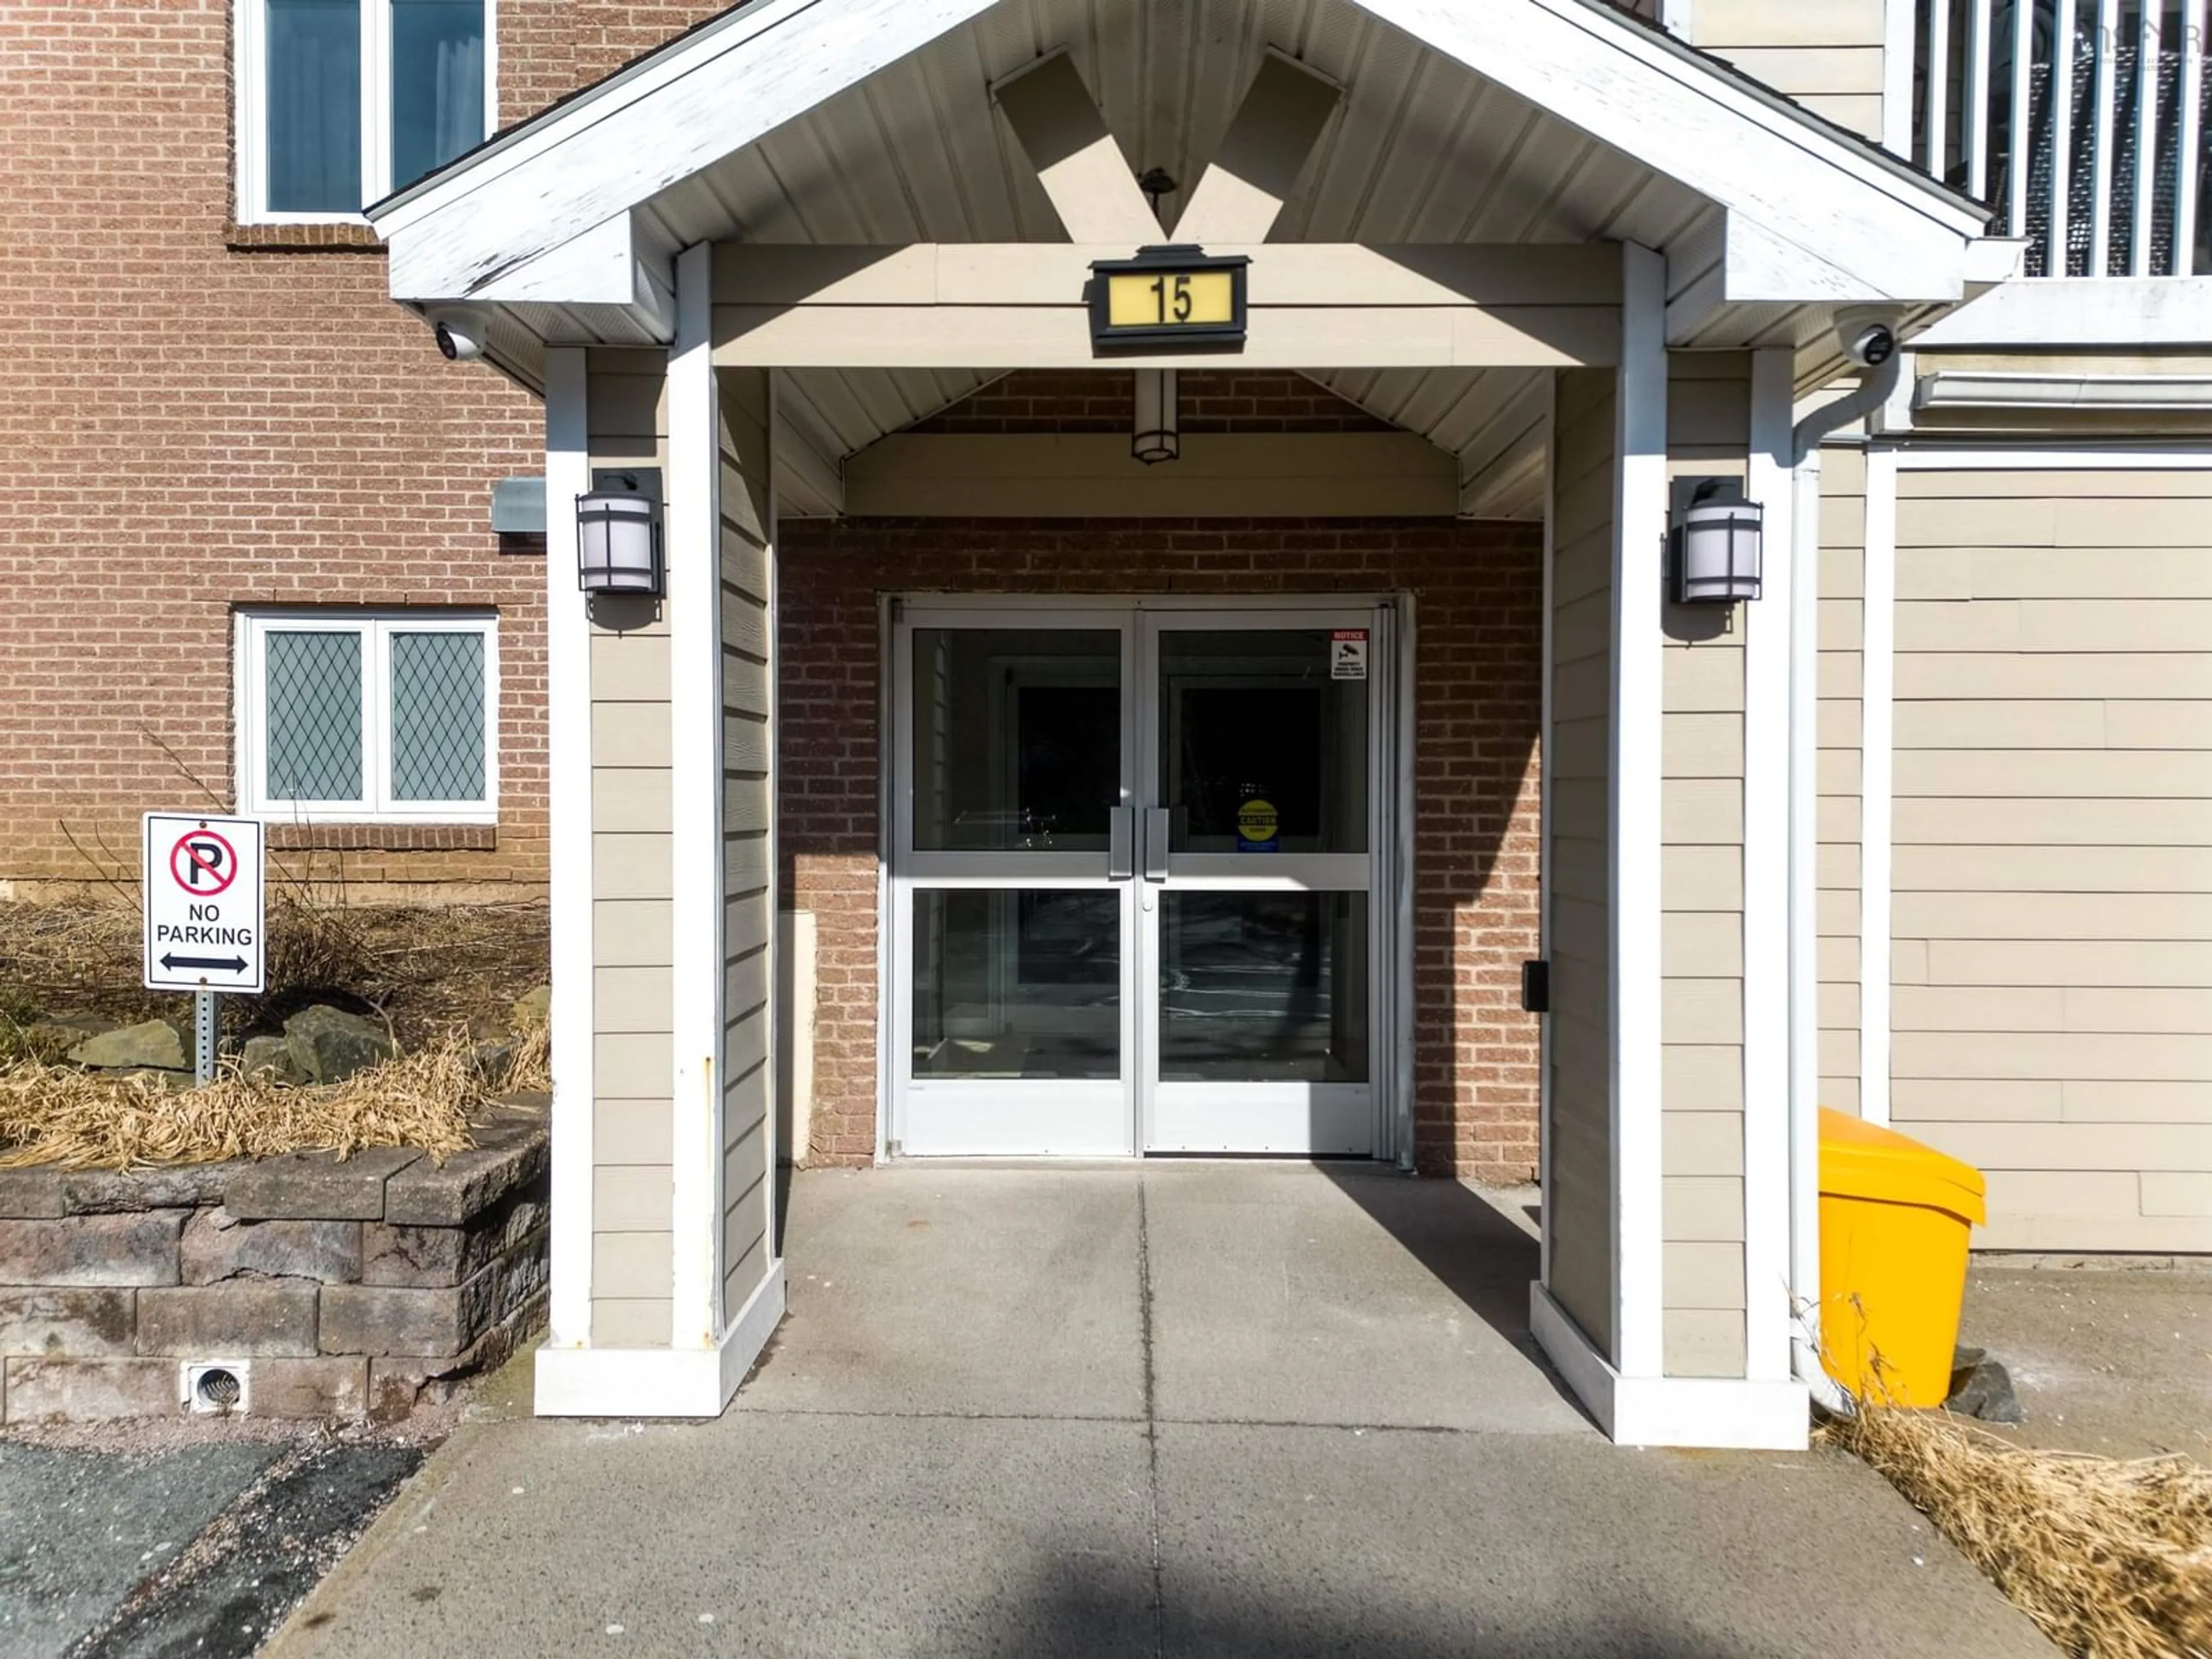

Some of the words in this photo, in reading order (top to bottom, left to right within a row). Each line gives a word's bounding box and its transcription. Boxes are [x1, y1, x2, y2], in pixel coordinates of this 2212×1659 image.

[1150, 274, 1192, 324] 15
[1334, 631, 1364, 639] NOTICE
[189, 903, 220, 922] NO
[157, 925, 252, 946] PARKING
